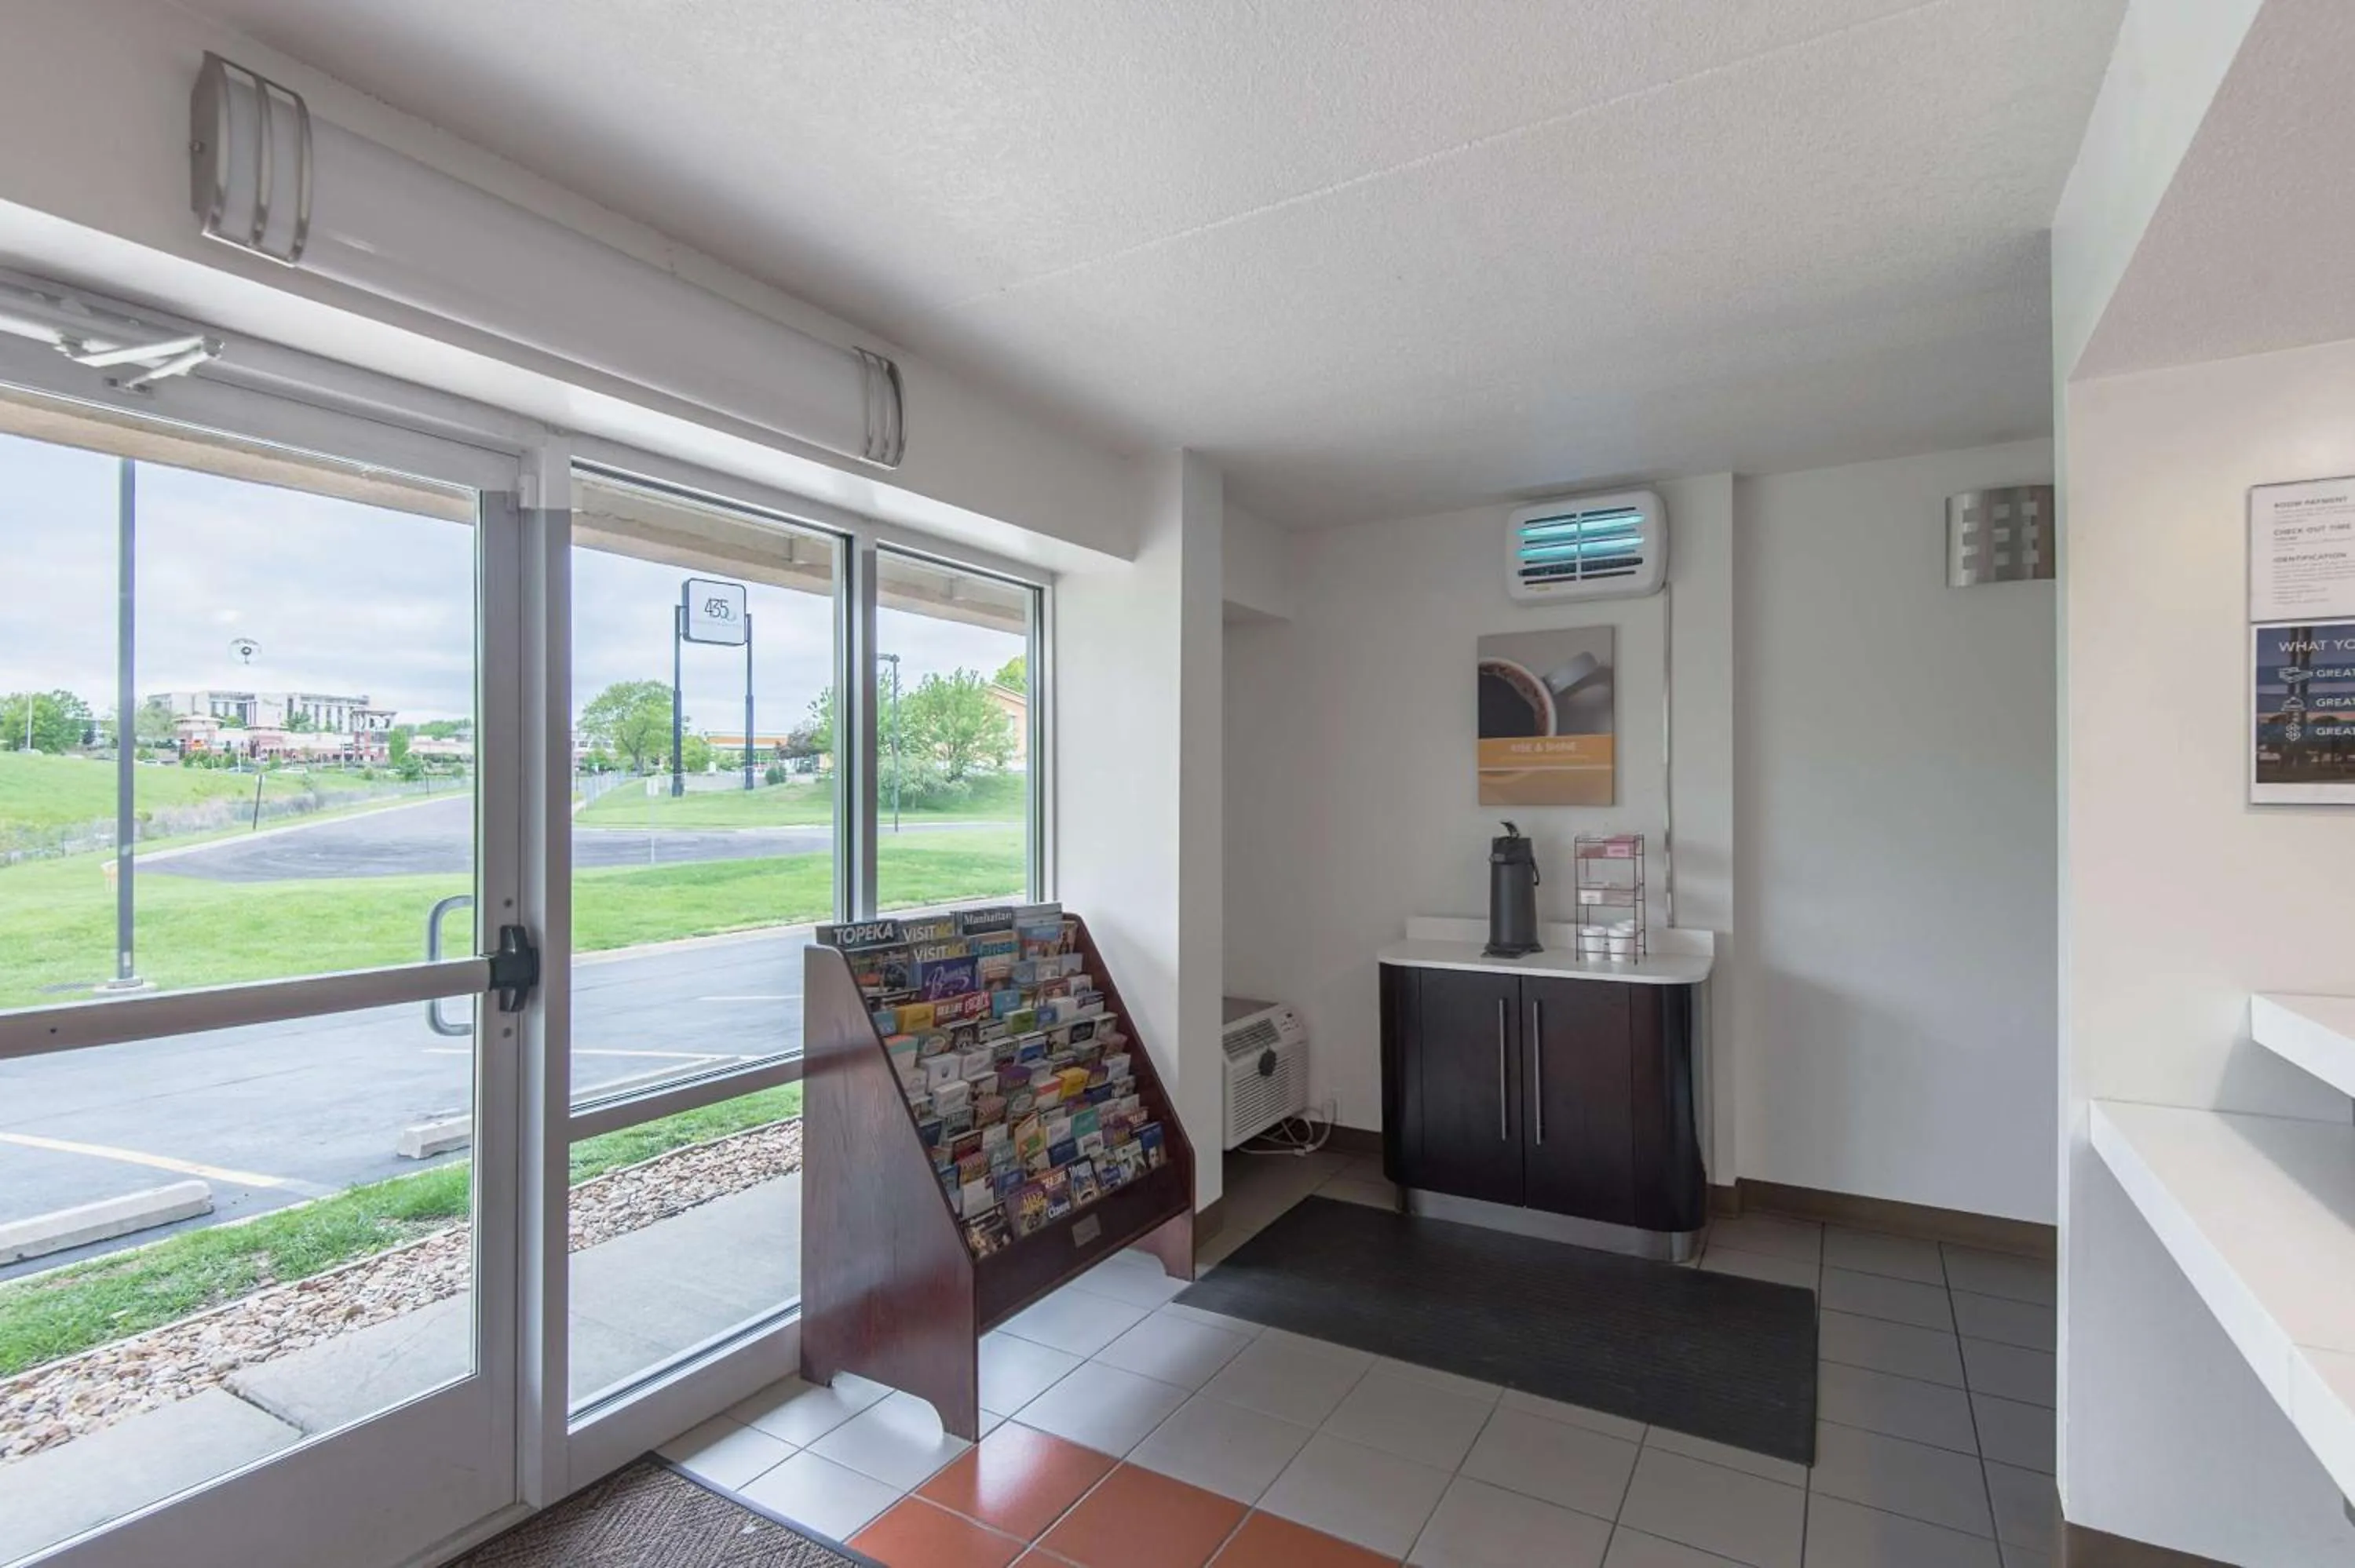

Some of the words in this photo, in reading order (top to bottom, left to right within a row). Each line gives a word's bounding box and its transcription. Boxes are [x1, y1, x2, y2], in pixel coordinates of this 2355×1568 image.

[2273, 527, 2303, 536] CHECK
[2306, 524, 2326, 534] OUT
[2273, 552, 2347, 563] IDENTIFICATION
[704, 598, 729, 619] 435
[2278, 640, 2328, 652] WHAT
[834, 922, 894, 944] TOPEKA
